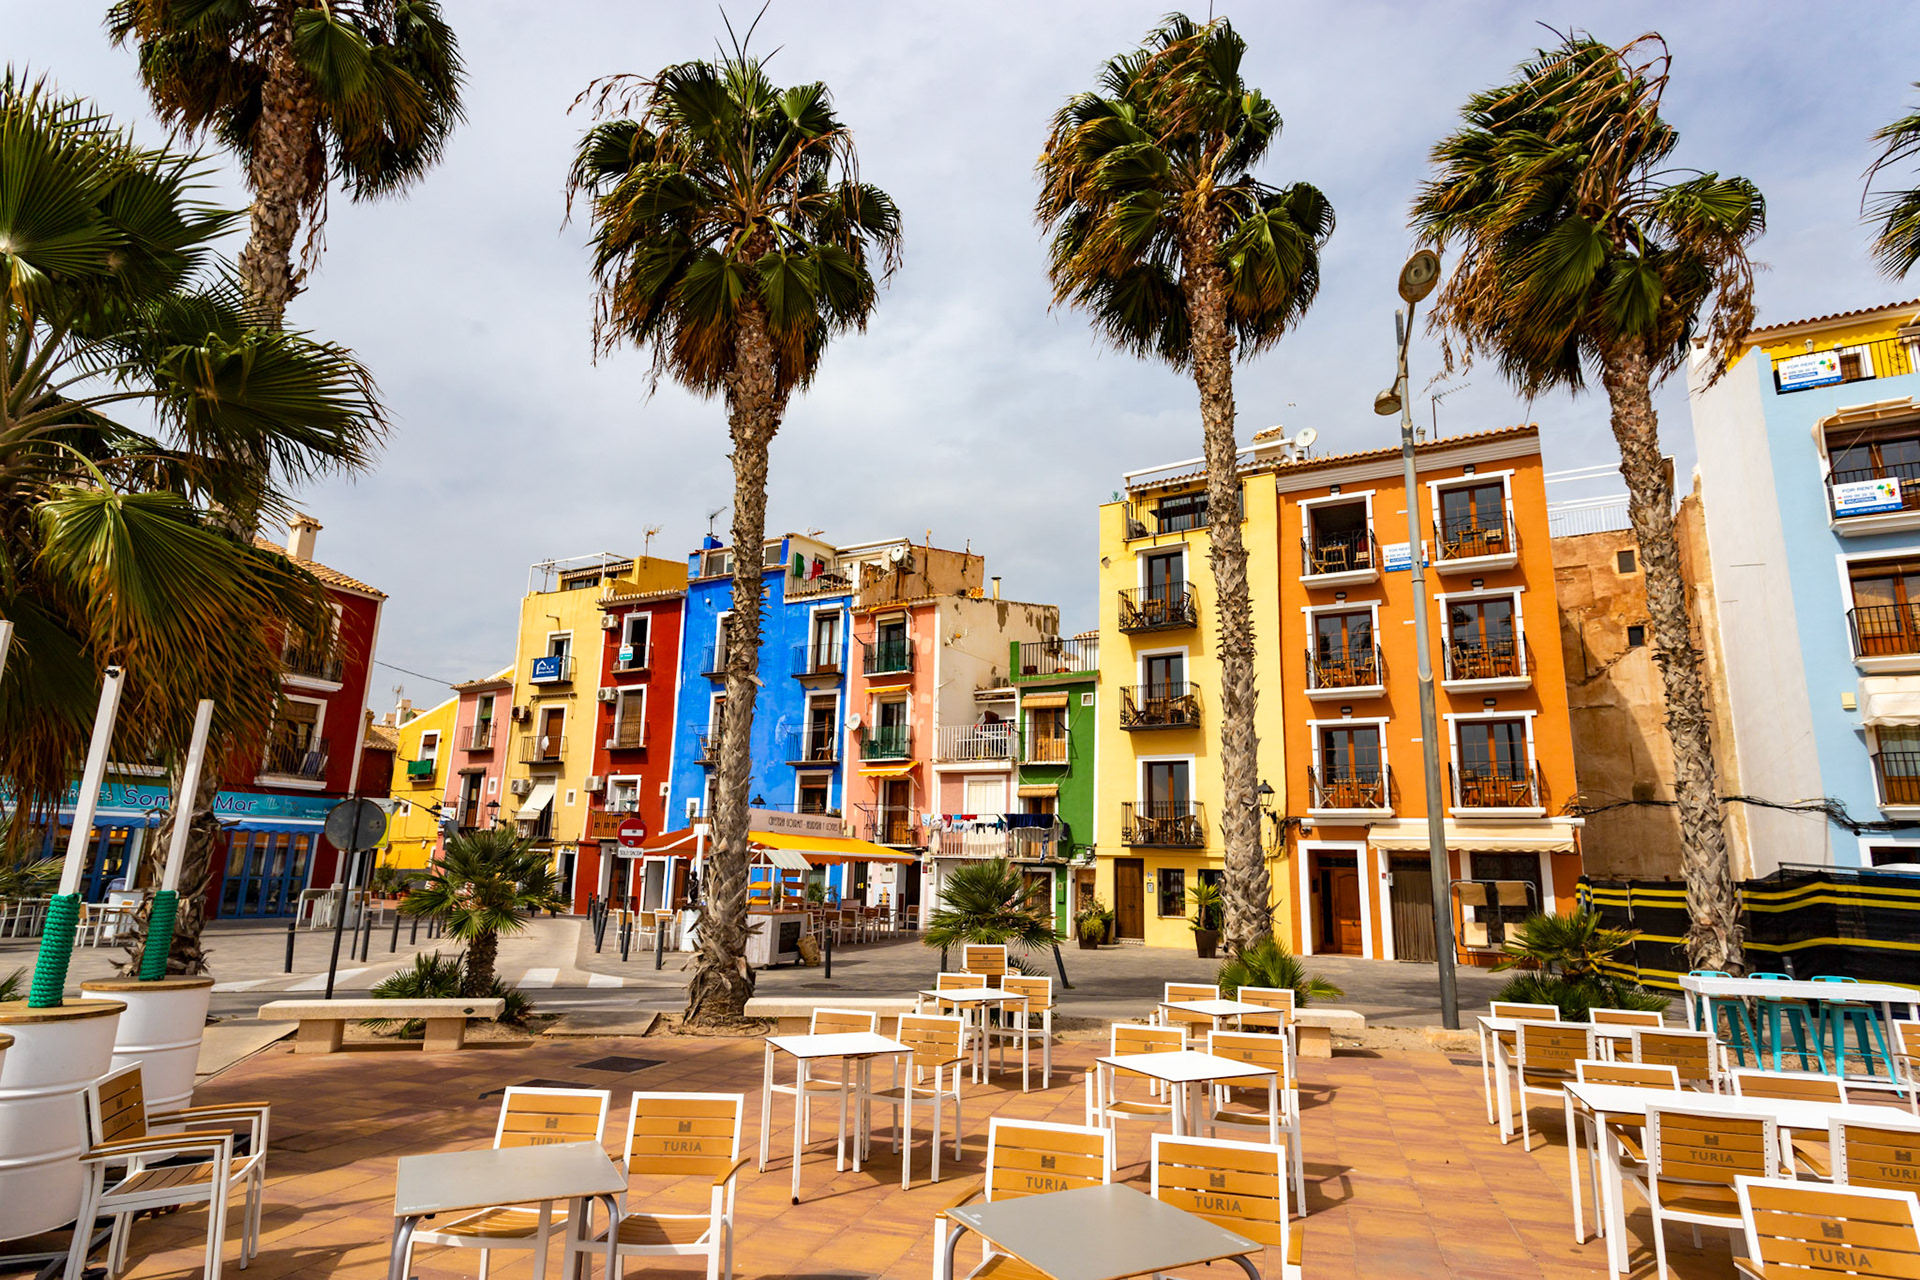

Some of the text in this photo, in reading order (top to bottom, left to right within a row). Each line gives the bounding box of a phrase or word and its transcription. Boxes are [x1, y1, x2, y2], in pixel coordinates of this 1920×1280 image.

[1845, 496, 1876, 504] VACATIONAL
[215, 794, 258, 811] Mar
[916, 1043, 940, 1052] TURIA
[1543, 1049, 1570, 1058] TURIA
[1661, 1058, 1689, 1066] TURIA
[663, 1141, 702, 1152] TURIA
[1690, 1150, 1735, 1163] TURIA
[1879, 1166, 1920, 1180] TURI
[1025, 1176, 1069, 1191] TURIA
[1194, 1195, 1243, 1213] TURIA
[1806, 1247, 1873, 1269] TURIA
